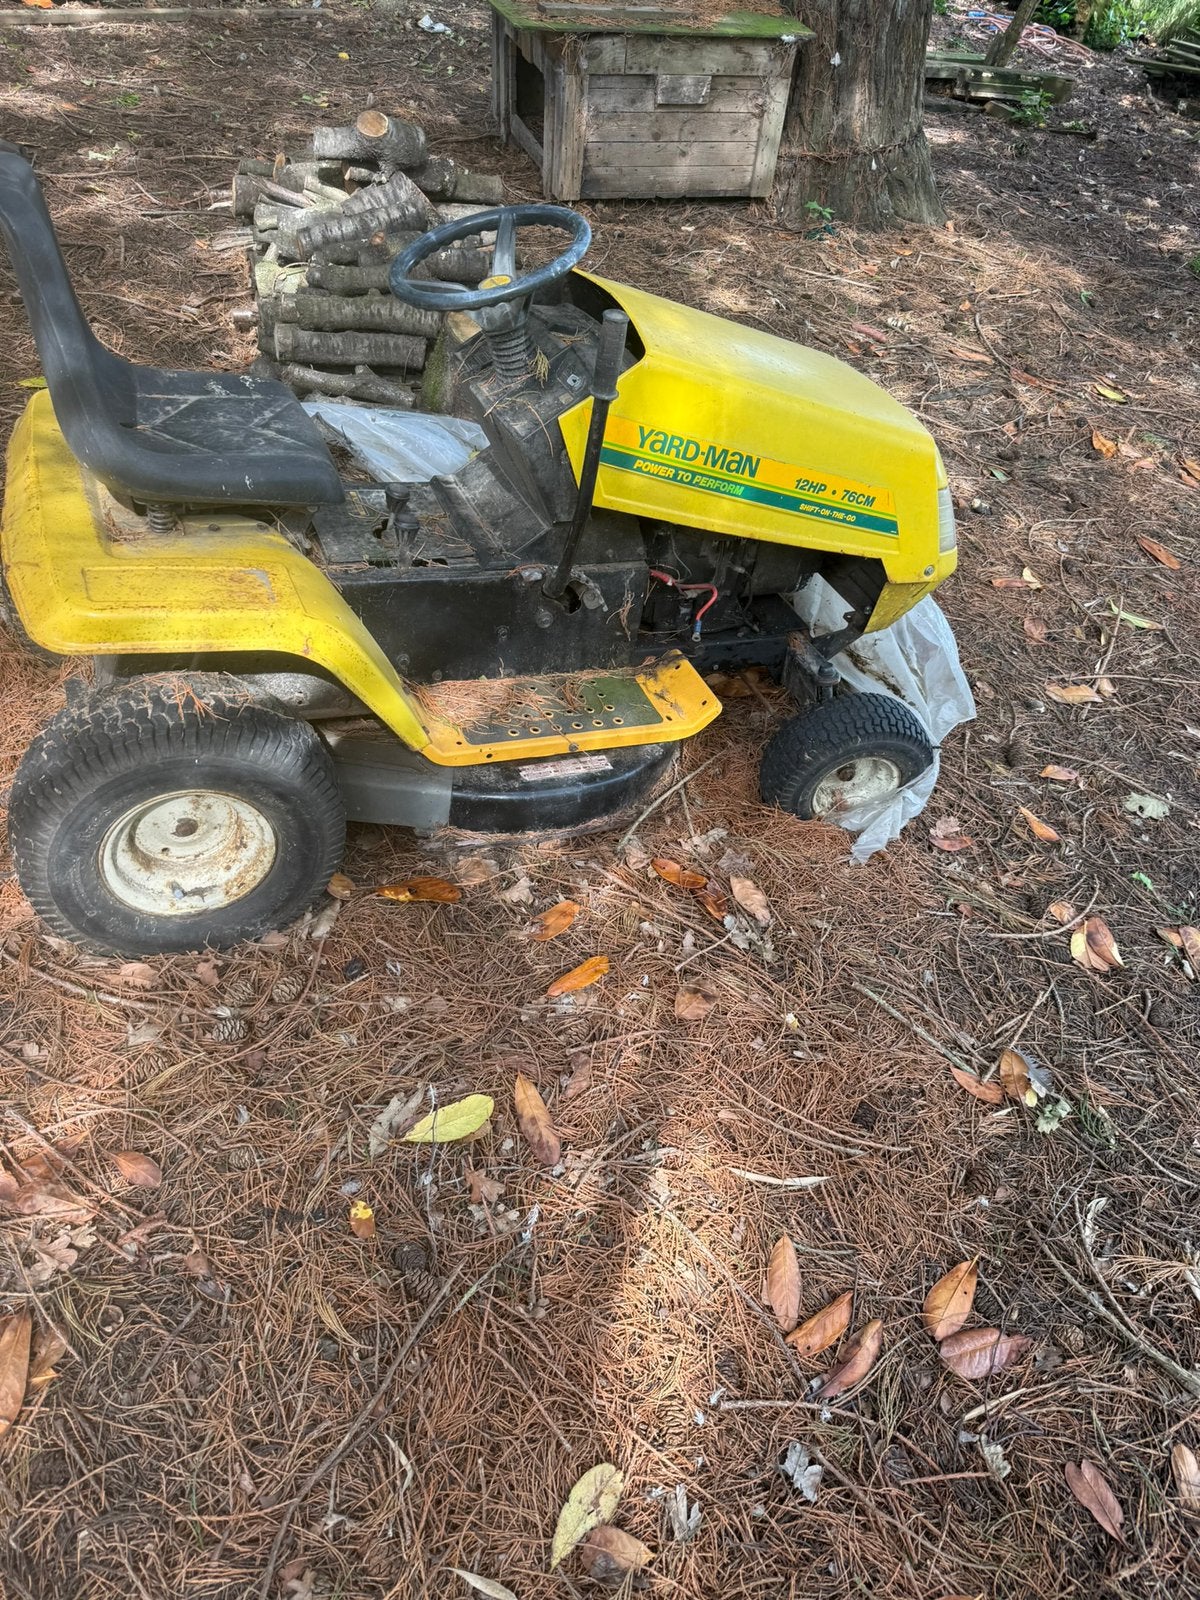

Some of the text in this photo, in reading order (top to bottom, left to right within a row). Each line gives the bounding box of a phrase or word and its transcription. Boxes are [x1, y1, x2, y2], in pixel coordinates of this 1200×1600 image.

[633, 459, 744, 496] POWER TO PERFORM
[794, 477, 876, 507] 12HP 76CM
